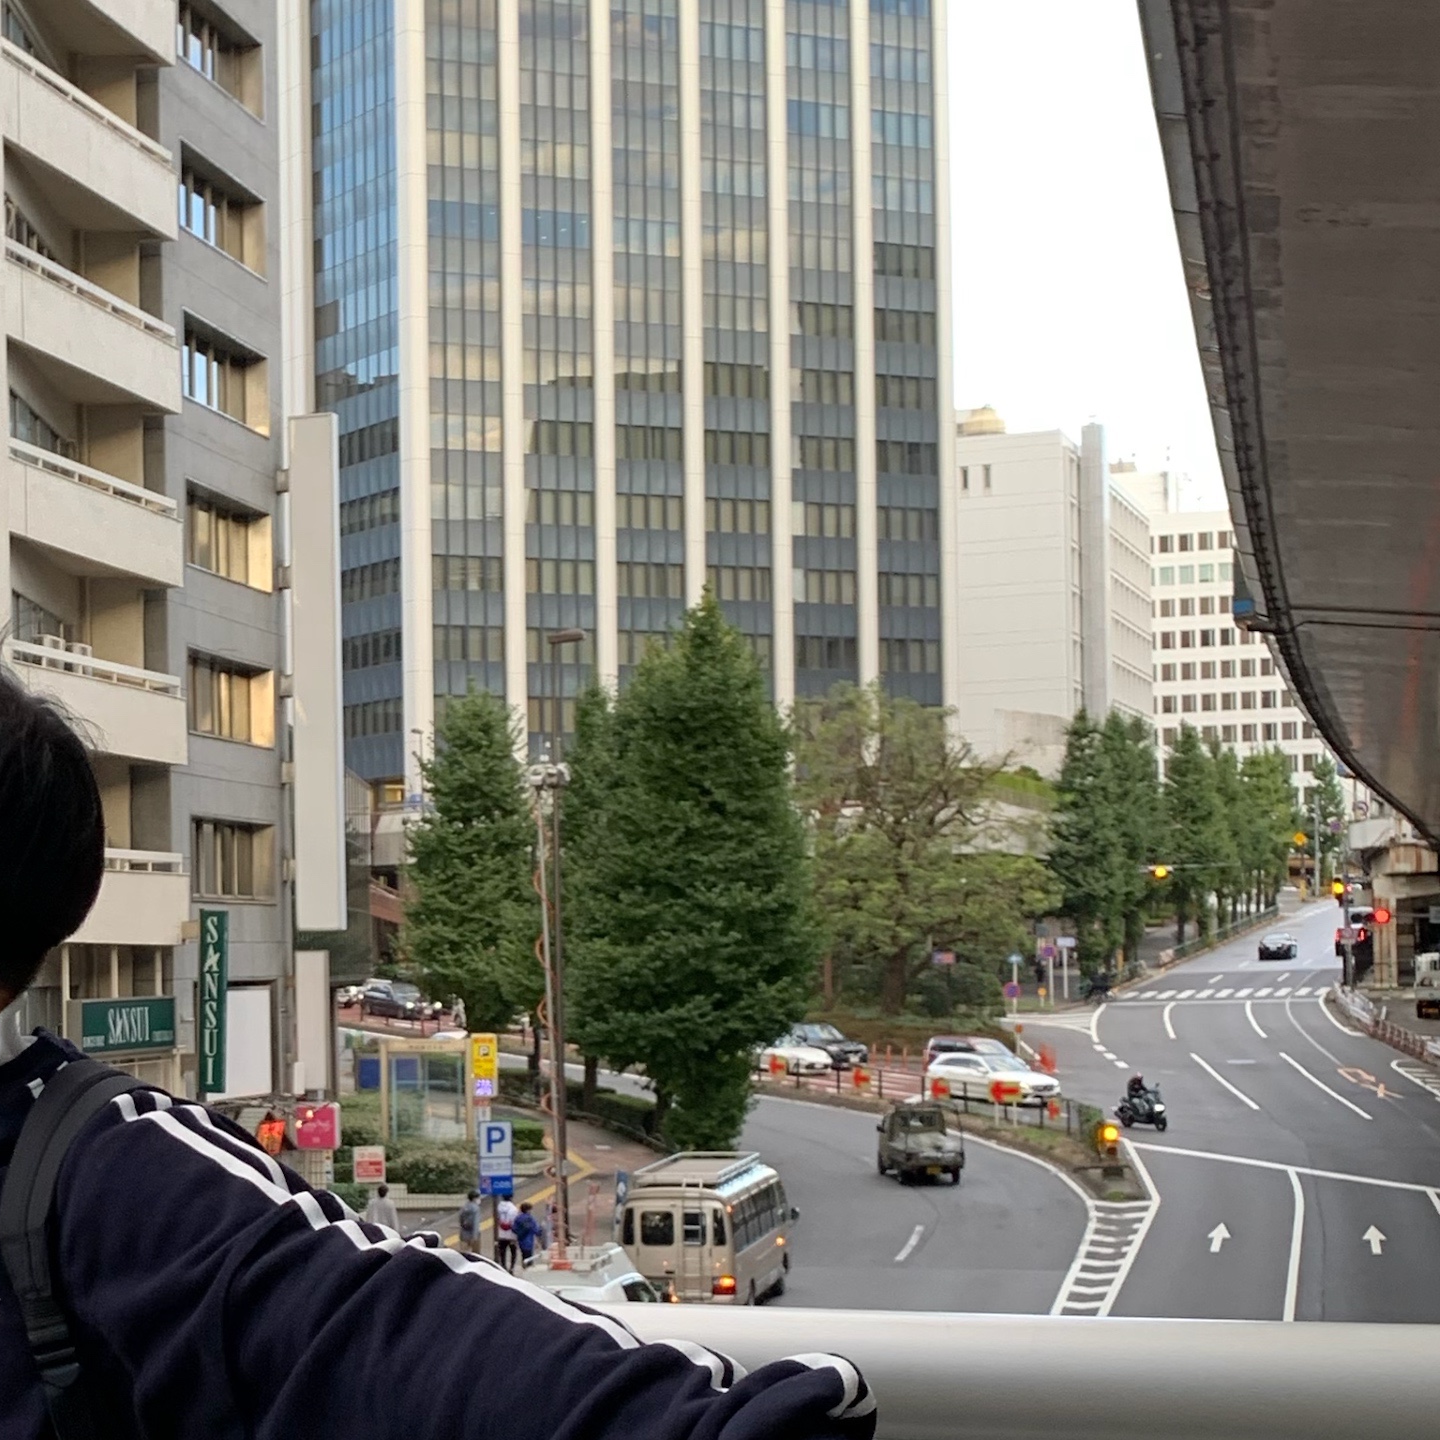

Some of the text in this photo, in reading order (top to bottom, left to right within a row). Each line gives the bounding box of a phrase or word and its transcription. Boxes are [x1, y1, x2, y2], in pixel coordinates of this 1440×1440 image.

[203, 916, 221, 1085] SANSUI
[108, 1007, 150, 1045] SANSUI
[486, 1127, 505, 1153] P
